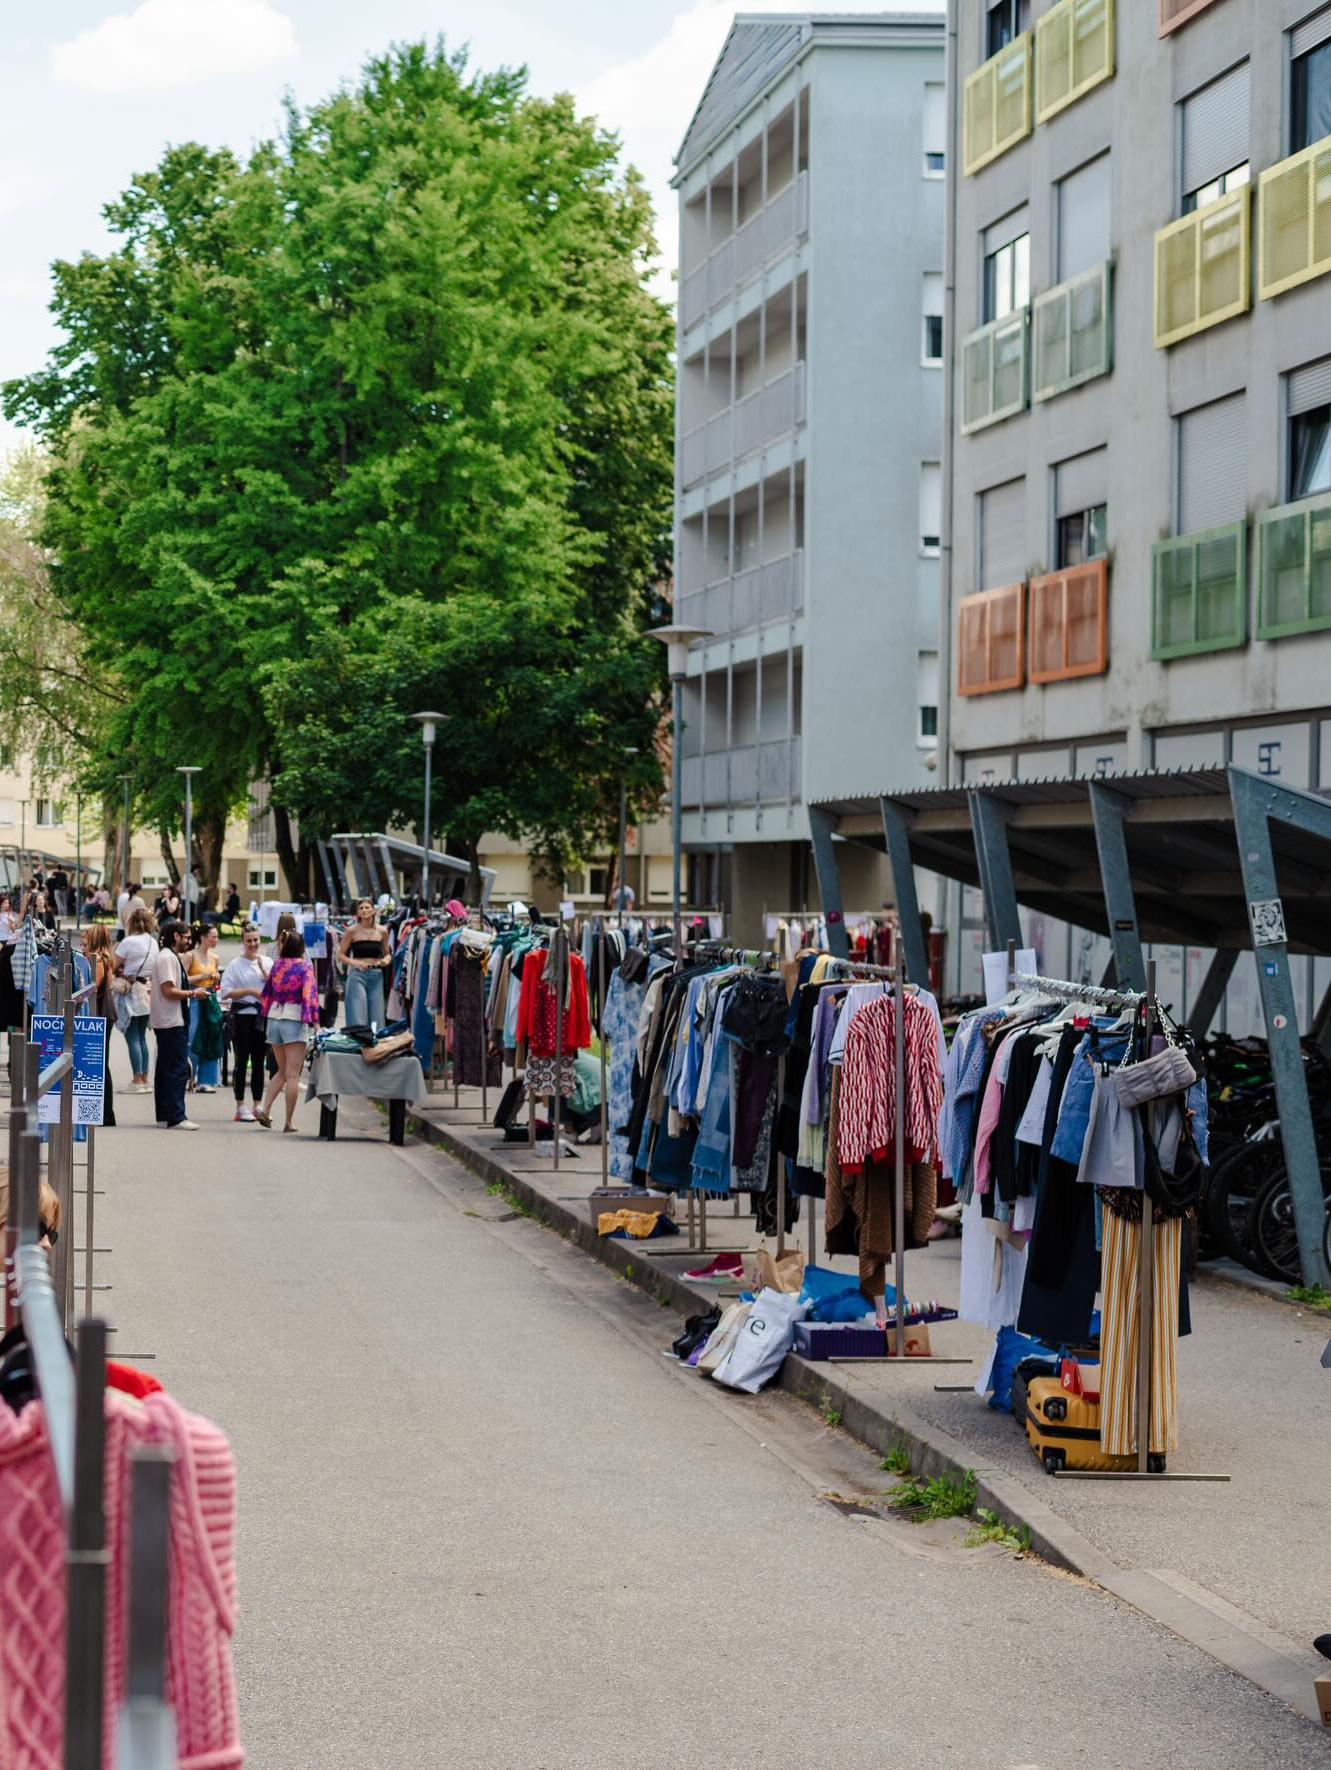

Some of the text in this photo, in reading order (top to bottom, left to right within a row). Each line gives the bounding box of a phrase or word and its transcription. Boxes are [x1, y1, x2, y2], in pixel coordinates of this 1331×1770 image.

[33, 1017, 104, 1032] NOĆN VLAK
[742, 1314, 766, 1336] re
